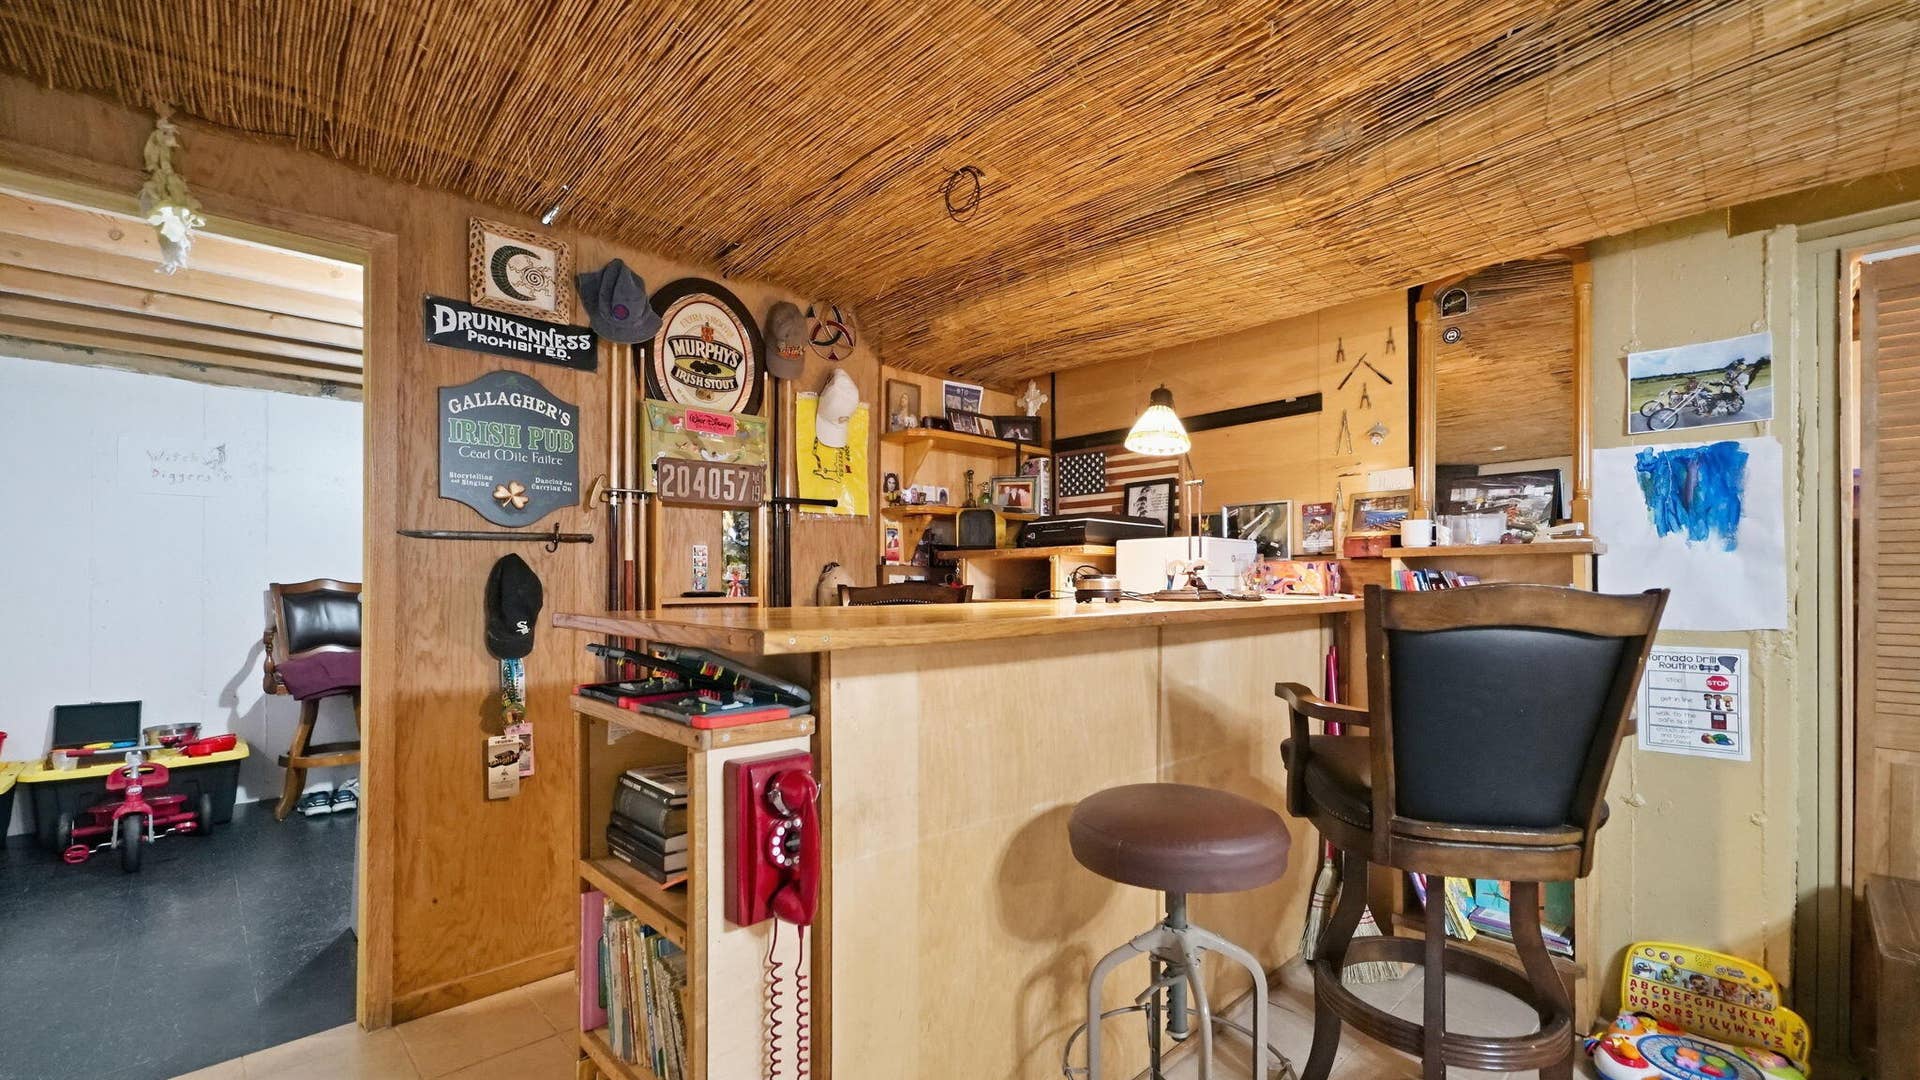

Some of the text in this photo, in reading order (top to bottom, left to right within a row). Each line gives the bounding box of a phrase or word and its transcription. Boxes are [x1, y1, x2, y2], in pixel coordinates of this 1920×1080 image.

[433, 304, 591, 351] DRUNKENNESS
[467, 330, 572, 360] PROHIBITED.
[675, 368, 734, 390] IRISH STOUT
[448, 391, 571, 426] GALLAGHER'S
[448, 417, 575, 454] IRISH PUB
[458, 445, 491, 460] Cead
[449, 471, 494, 481] Storytelling
[535, 477, 563, 486] Dancing
[662, 463, 750, 501] 204057
[531, 483, 561, 492] Carrying
[1659, 661, 1698, 671] Routine
[1696, 655, 1717, 664] Drill
